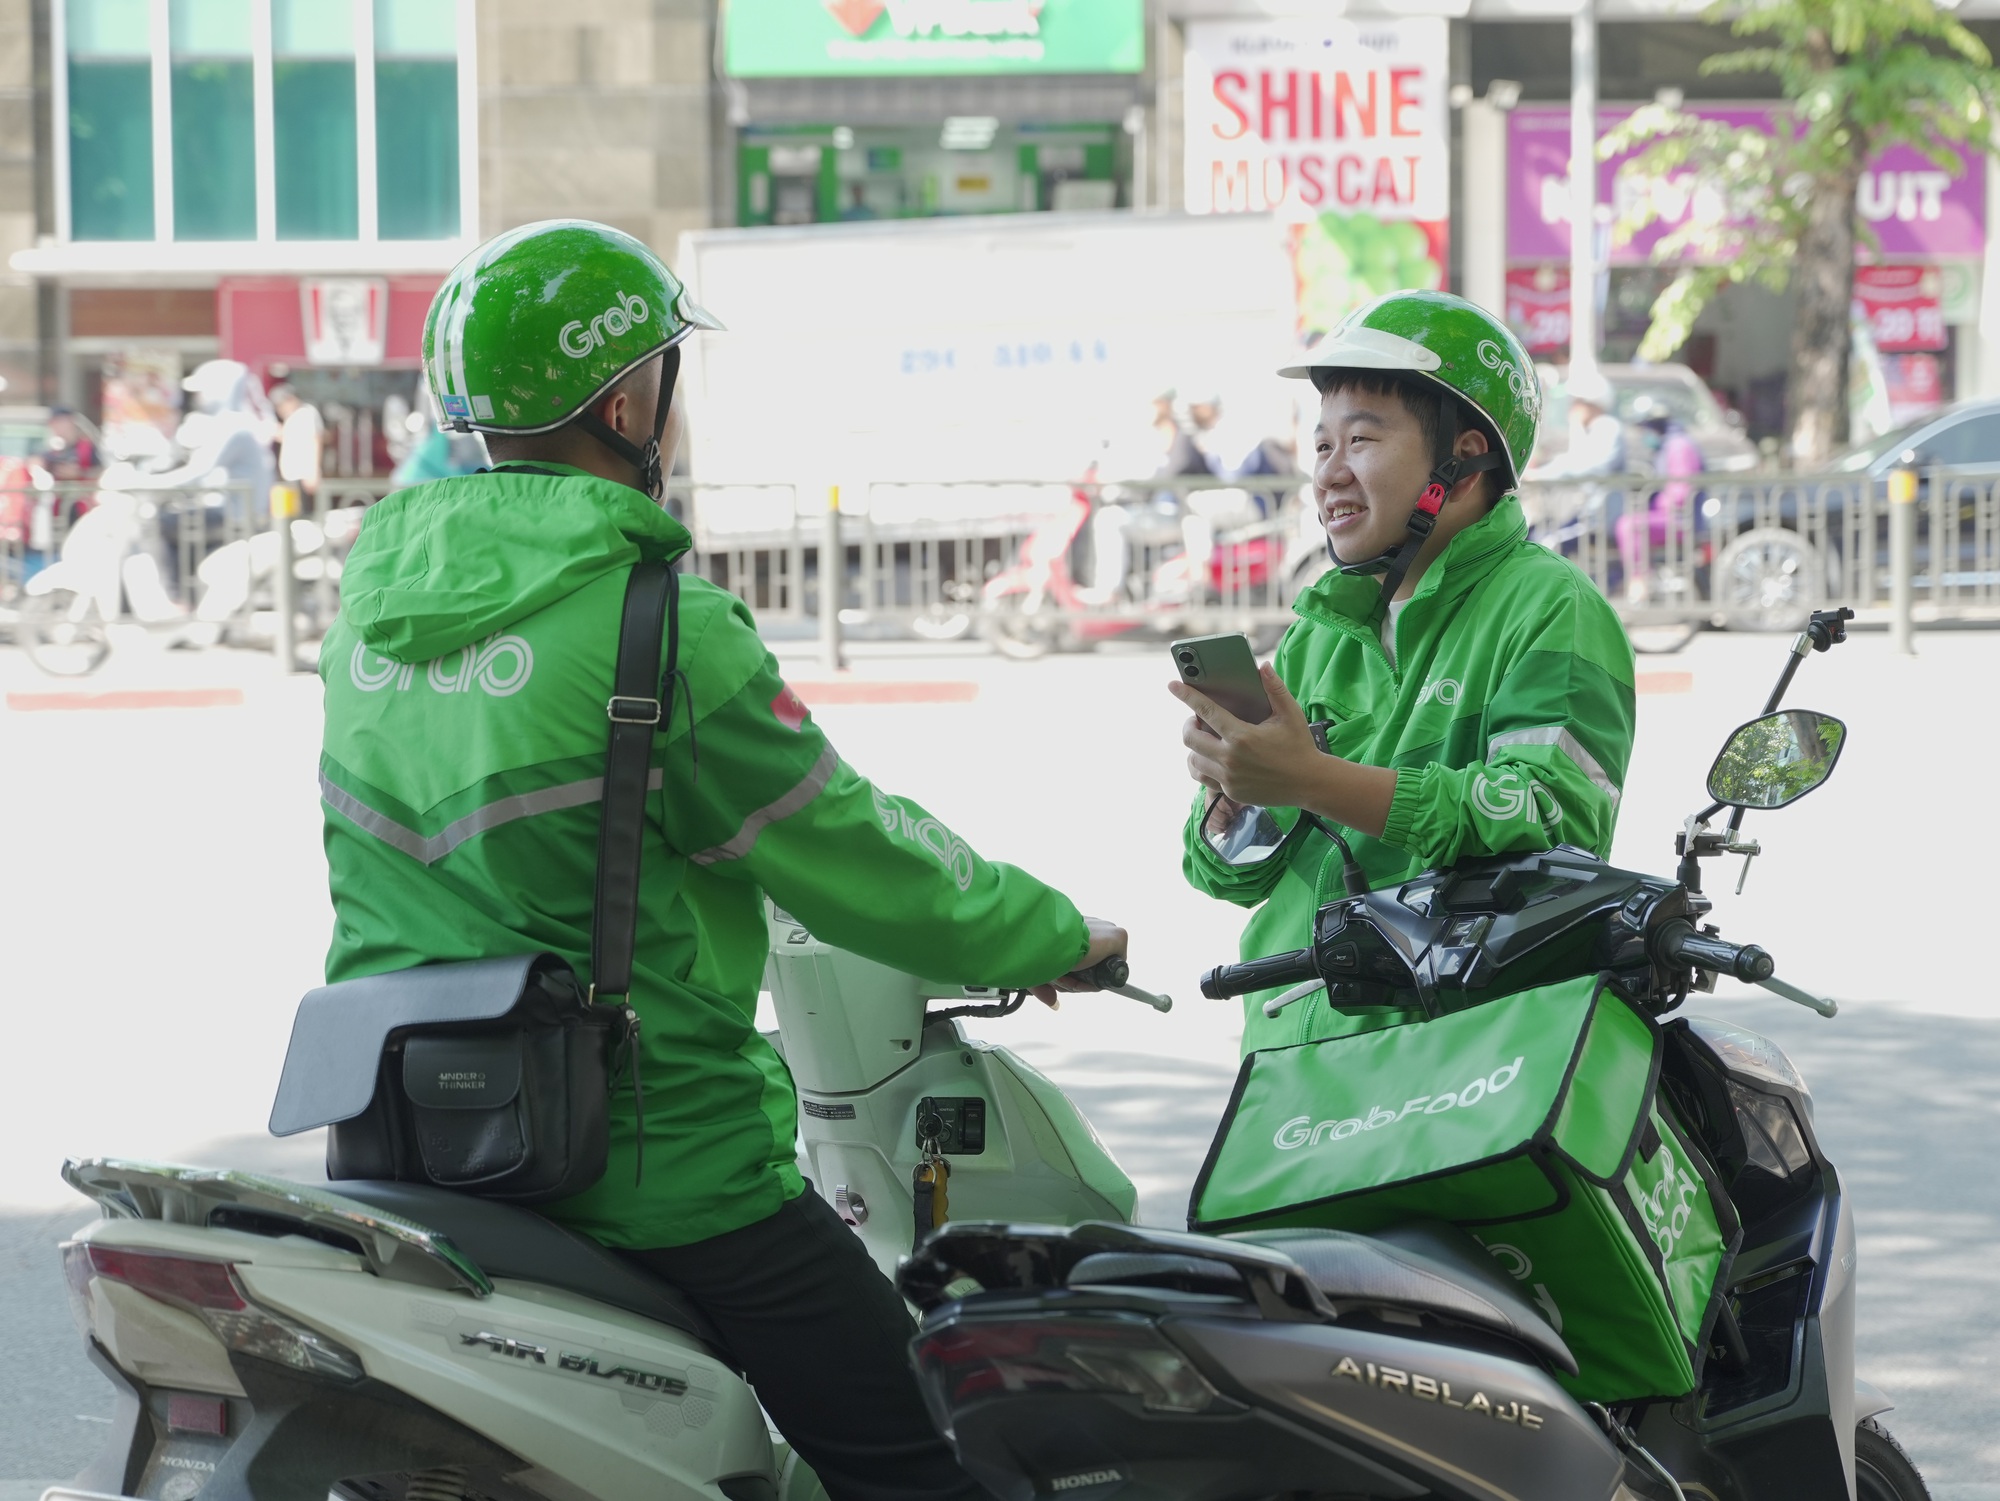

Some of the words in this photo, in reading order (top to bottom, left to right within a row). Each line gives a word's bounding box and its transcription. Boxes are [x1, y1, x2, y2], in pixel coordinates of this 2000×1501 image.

[1212, 66, 1422, 140] SHINE
[1211, 154, 1422, 213] MUSCAT
[559, 290, 649, 359] Grab
[459, 1331, 547, 1364] AIR
[558, 1351, 688, 1396] BLADE
[161, 1455, 215, 1472] HONDA
[1052, 1469, 1123, 1491] HONDA
